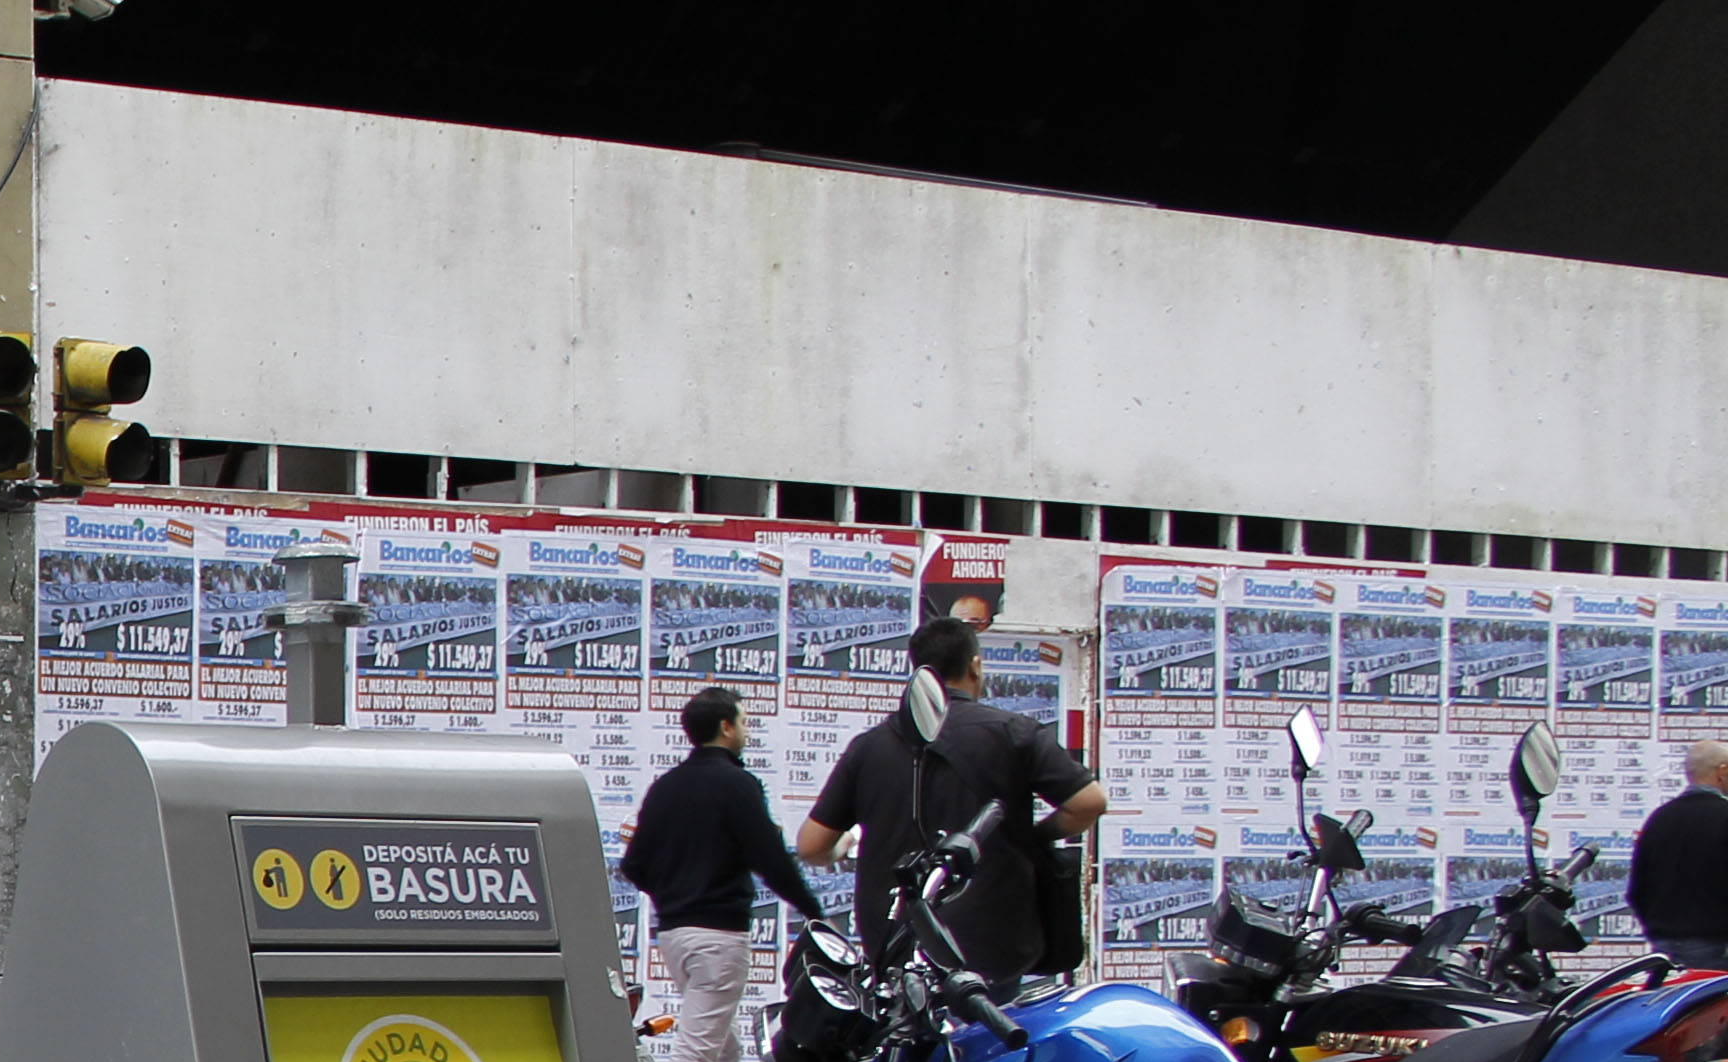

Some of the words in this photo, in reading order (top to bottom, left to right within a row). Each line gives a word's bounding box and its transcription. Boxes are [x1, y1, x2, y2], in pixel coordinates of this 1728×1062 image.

[65, 516, 168, 543] Bancarios
[380, 541, 473, 564] Bancarios
[952, 561, 995, 578] AHORA
[51, 600, 147, 627] SALARIOS
[59, 622, 85, 648] 29%
[129, 625, 189, 655] 11.549,37
[367, 619, 455, 646] SALARIOS
[41, 660, 51, 674] EL
[53, 661, 81, 675] MEJOR
[84, 662, 123, 678] ACUERDO
[126, 663, 165, 679] SALARIAL
[167, 665, 189, 680] PARA
[439, 644, 493, 672] 11.549,37
[41, 677, 55, 691] UN
[57, 678, 89, 692] NUEVO
[92, 679, 139, 695] CONVENIO
[142, 681, 189, 696] COLECTIVO
[363, 842, 456, 864] DEPOSITÁ
[462, 843, 501, 864] ACÁ
[506, 847, 530, 864] TU
[368, 867, 536, 904] BASURA
[375, 909, 407, 921] (SOLO
[410, 910, 462, 921] RESIDUOS
[465, 910, 539, 922] EMBOLSADOS)
[1316, 1031, 1429, 1055] SUZUKI
